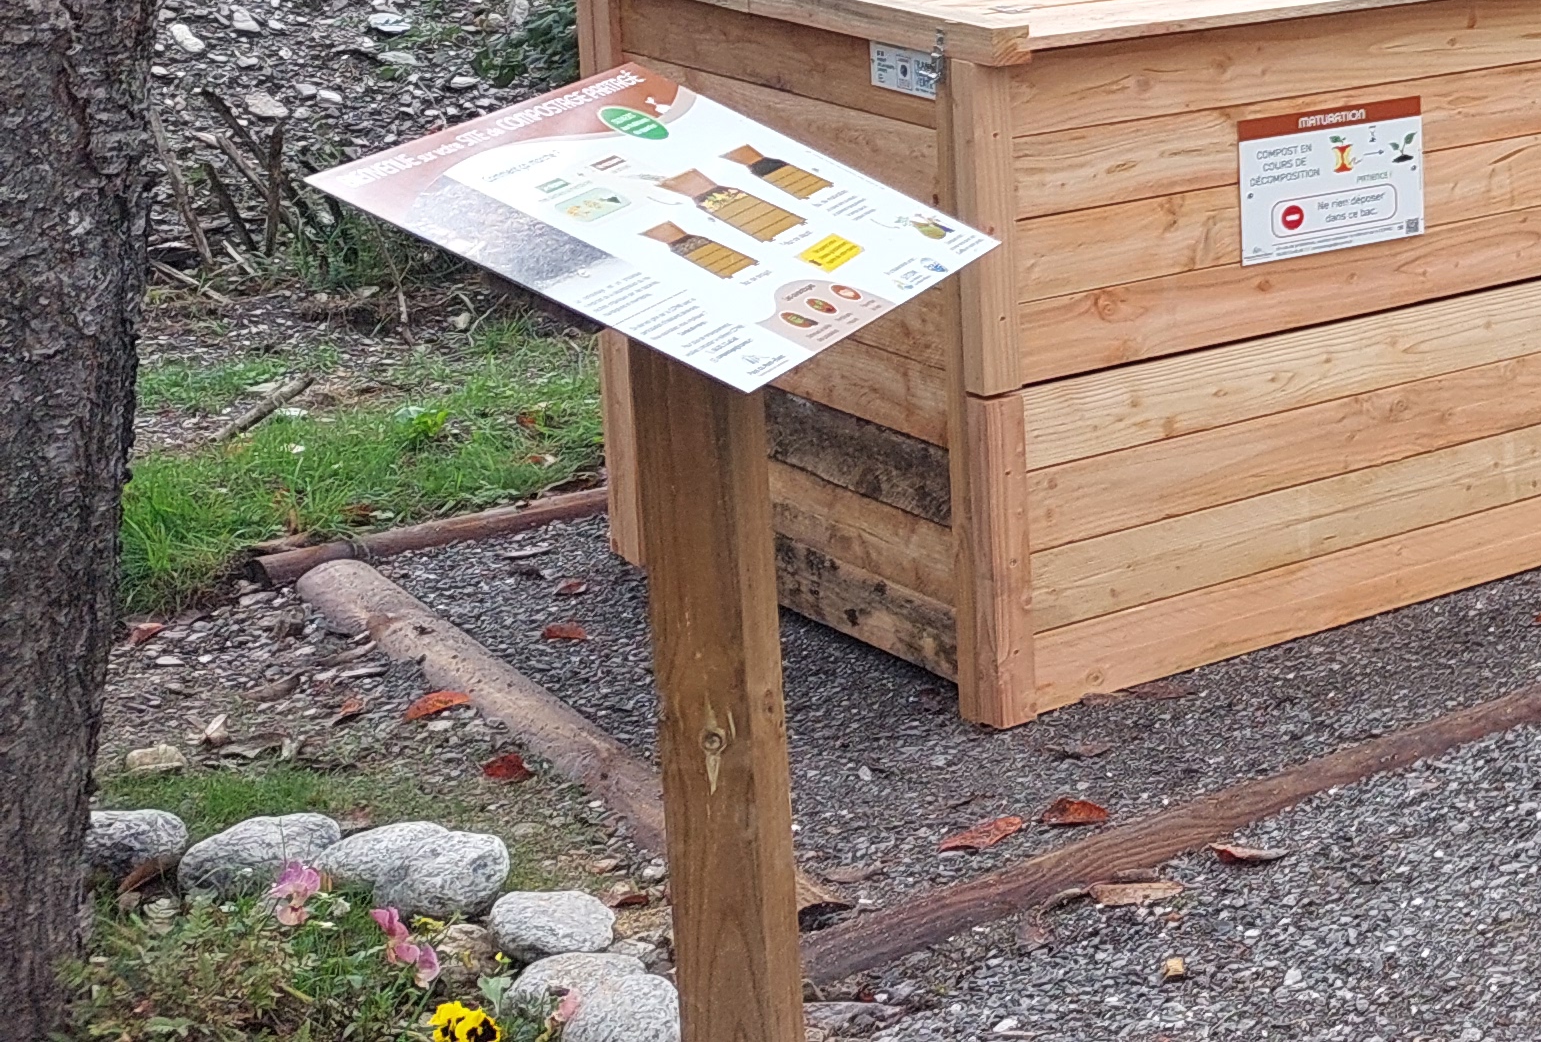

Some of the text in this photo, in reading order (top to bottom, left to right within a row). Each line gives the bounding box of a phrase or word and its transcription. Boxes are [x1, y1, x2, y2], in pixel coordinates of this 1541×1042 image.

[586, 69, 646, 101] PARTAGÉ
[496, 88, 593, 132] COMPOSTAGE
[1298, 109, 1366, 129] MATURATION
[459, 129, 491, 147] SITE
[488, 124, 505, 136] de
[418, 149, 438, 162] sur
[435, 140, 464, 158] votre
[1256, 143, 1312, 160] COMPOST EN
[336, 153, 421, 187] BIENVENUE
[1263, 157, 1307, 172] COURS DE
[1249, 167, 1320, 187] DÉCOMPOSITION
[1317, 191, 1386, 211] Ne rien déposer
[1325, 211, 1346, 223] dans
[1348, 210, 1358, 219] ce
